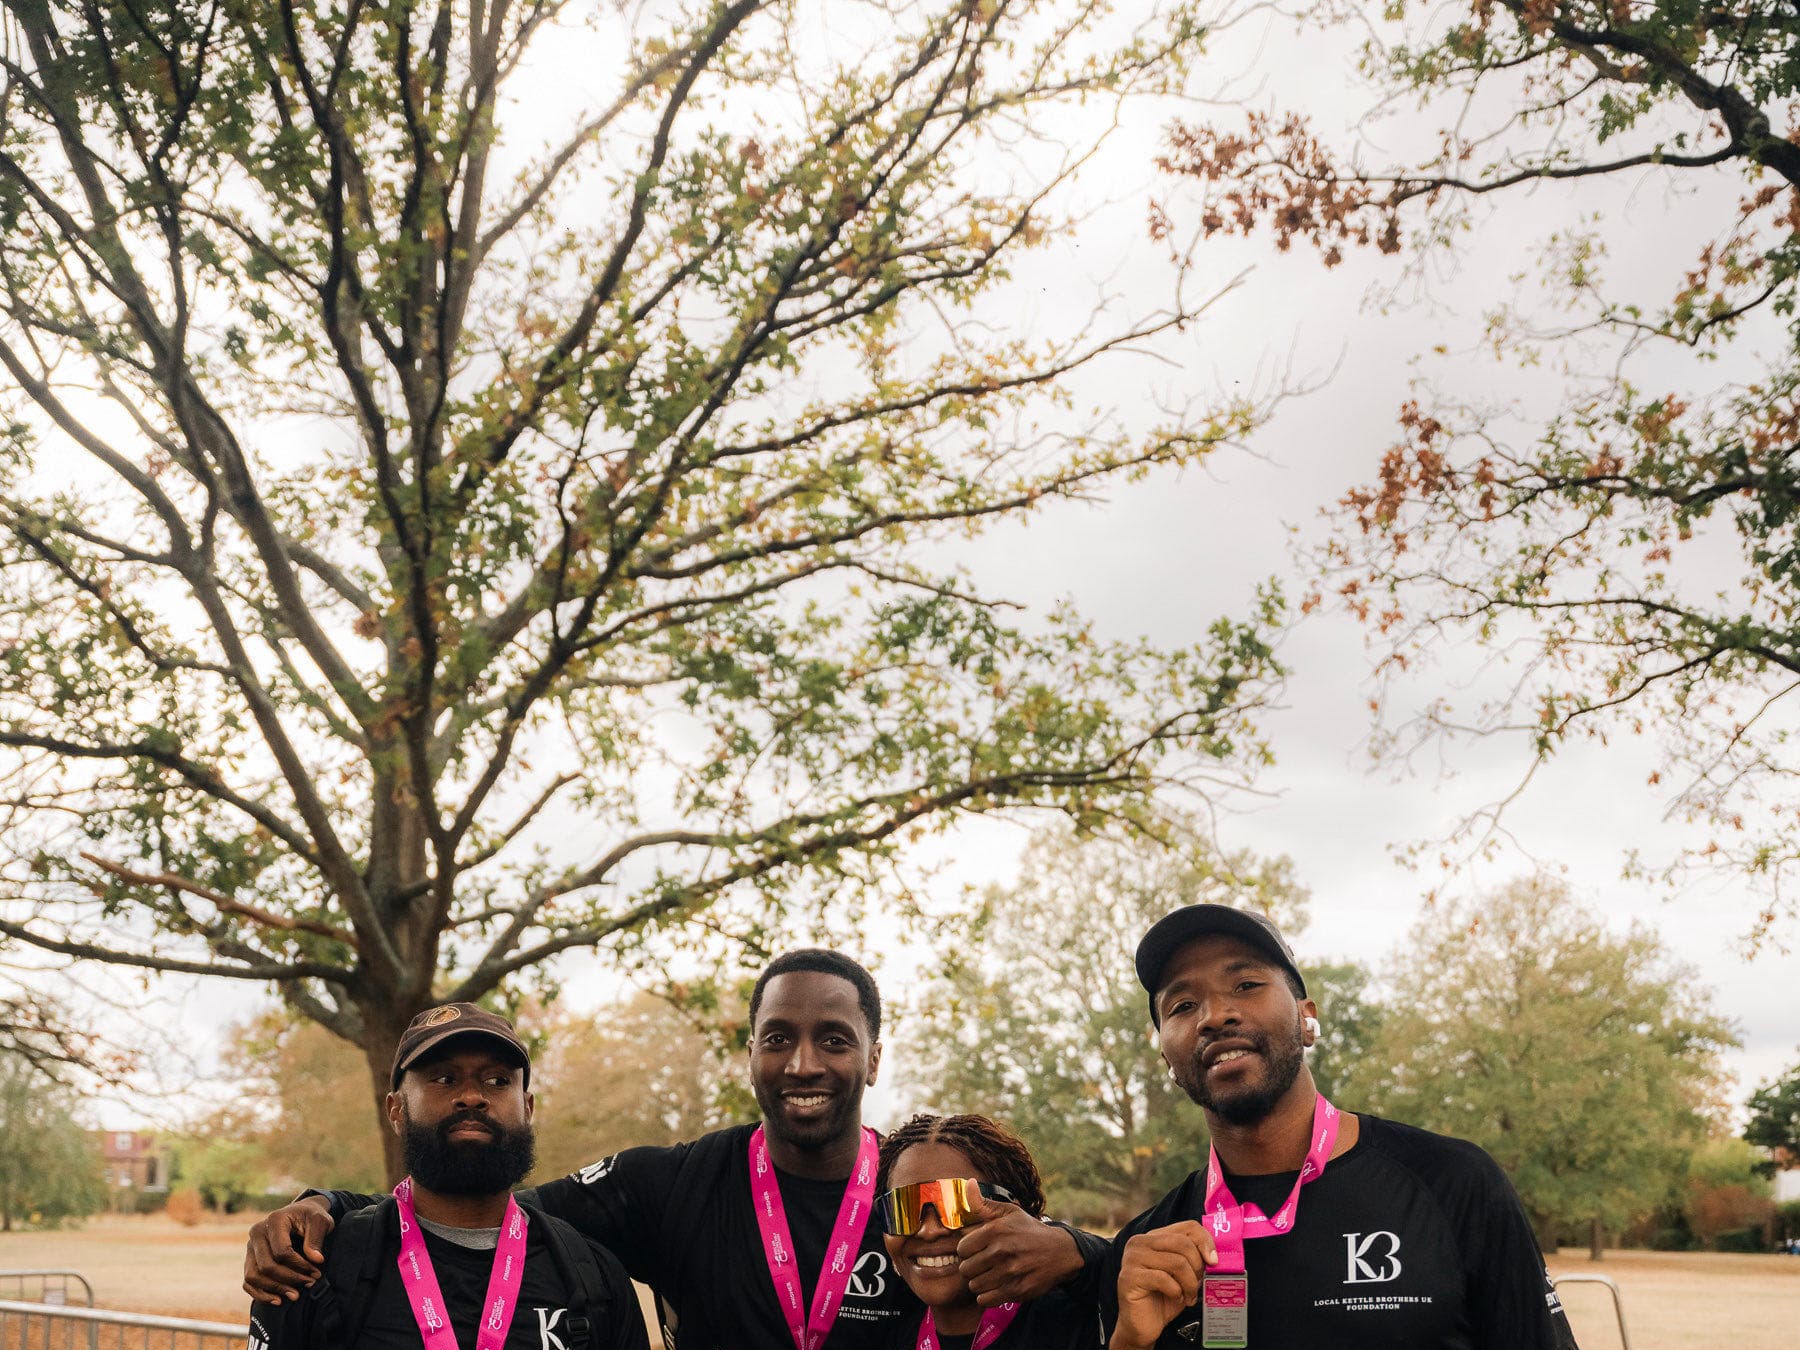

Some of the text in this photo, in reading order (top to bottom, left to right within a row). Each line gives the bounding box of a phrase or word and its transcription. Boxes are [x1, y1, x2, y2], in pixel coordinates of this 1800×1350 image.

[1314, 1299, 1340, 1307] LOCAL
[1346, 1303, 1400, 1311] FOUNDATION
[838, 1306, 861, 1314] ETTLE
